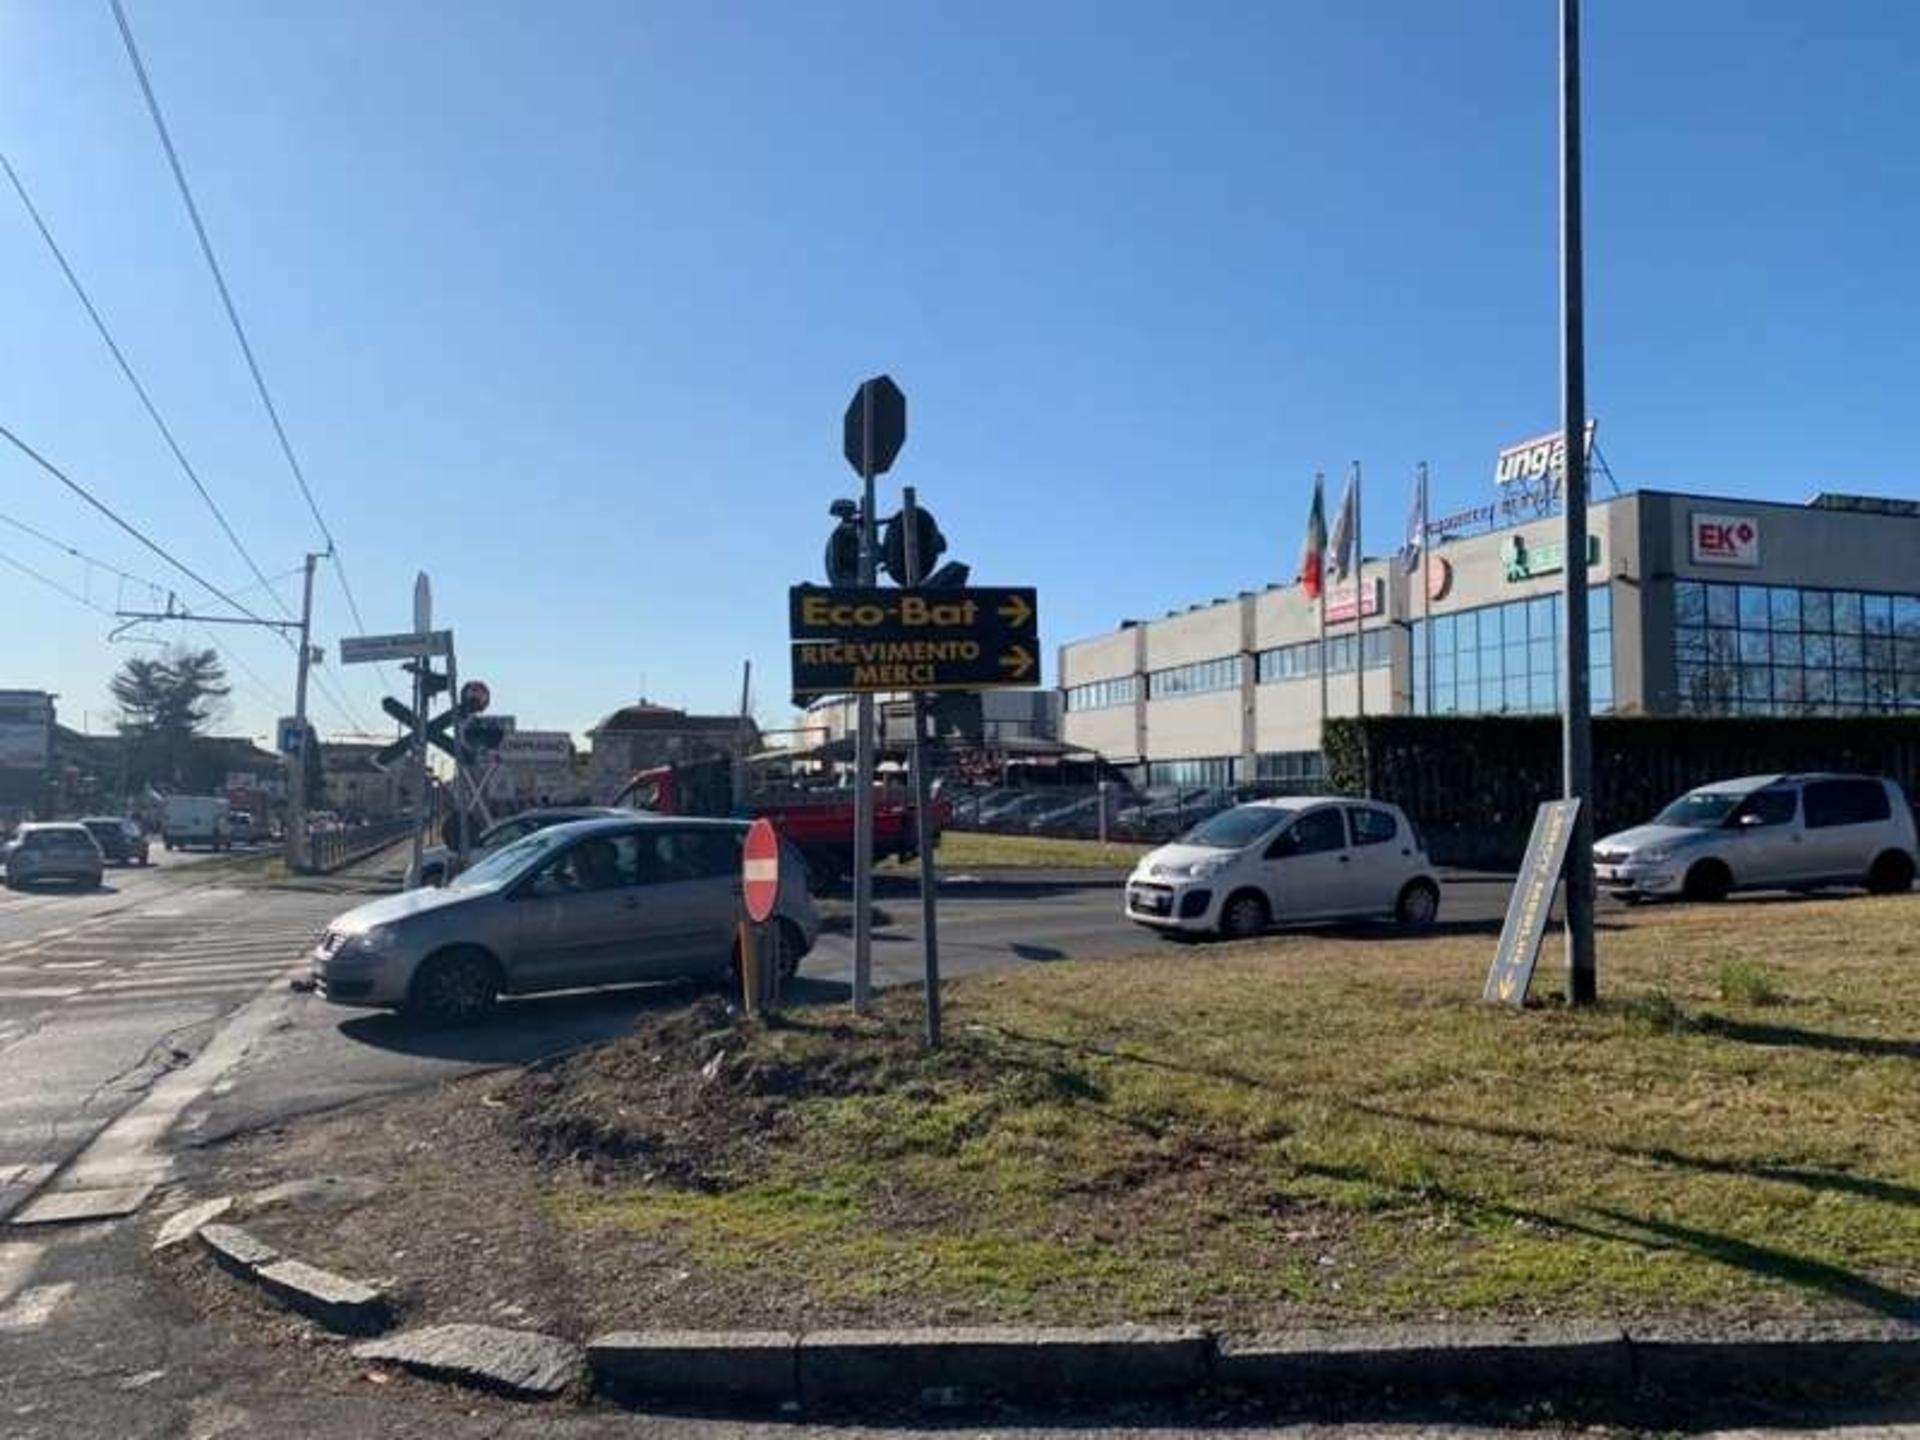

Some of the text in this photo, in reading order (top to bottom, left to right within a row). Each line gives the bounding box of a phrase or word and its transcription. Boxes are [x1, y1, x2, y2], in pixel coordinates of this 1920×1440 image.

[802, 596, 979, 626] Eco-Bat
[801, 641, 980, 665] RICEVIMENTO
[853, 664, 935, 685] MERCI
